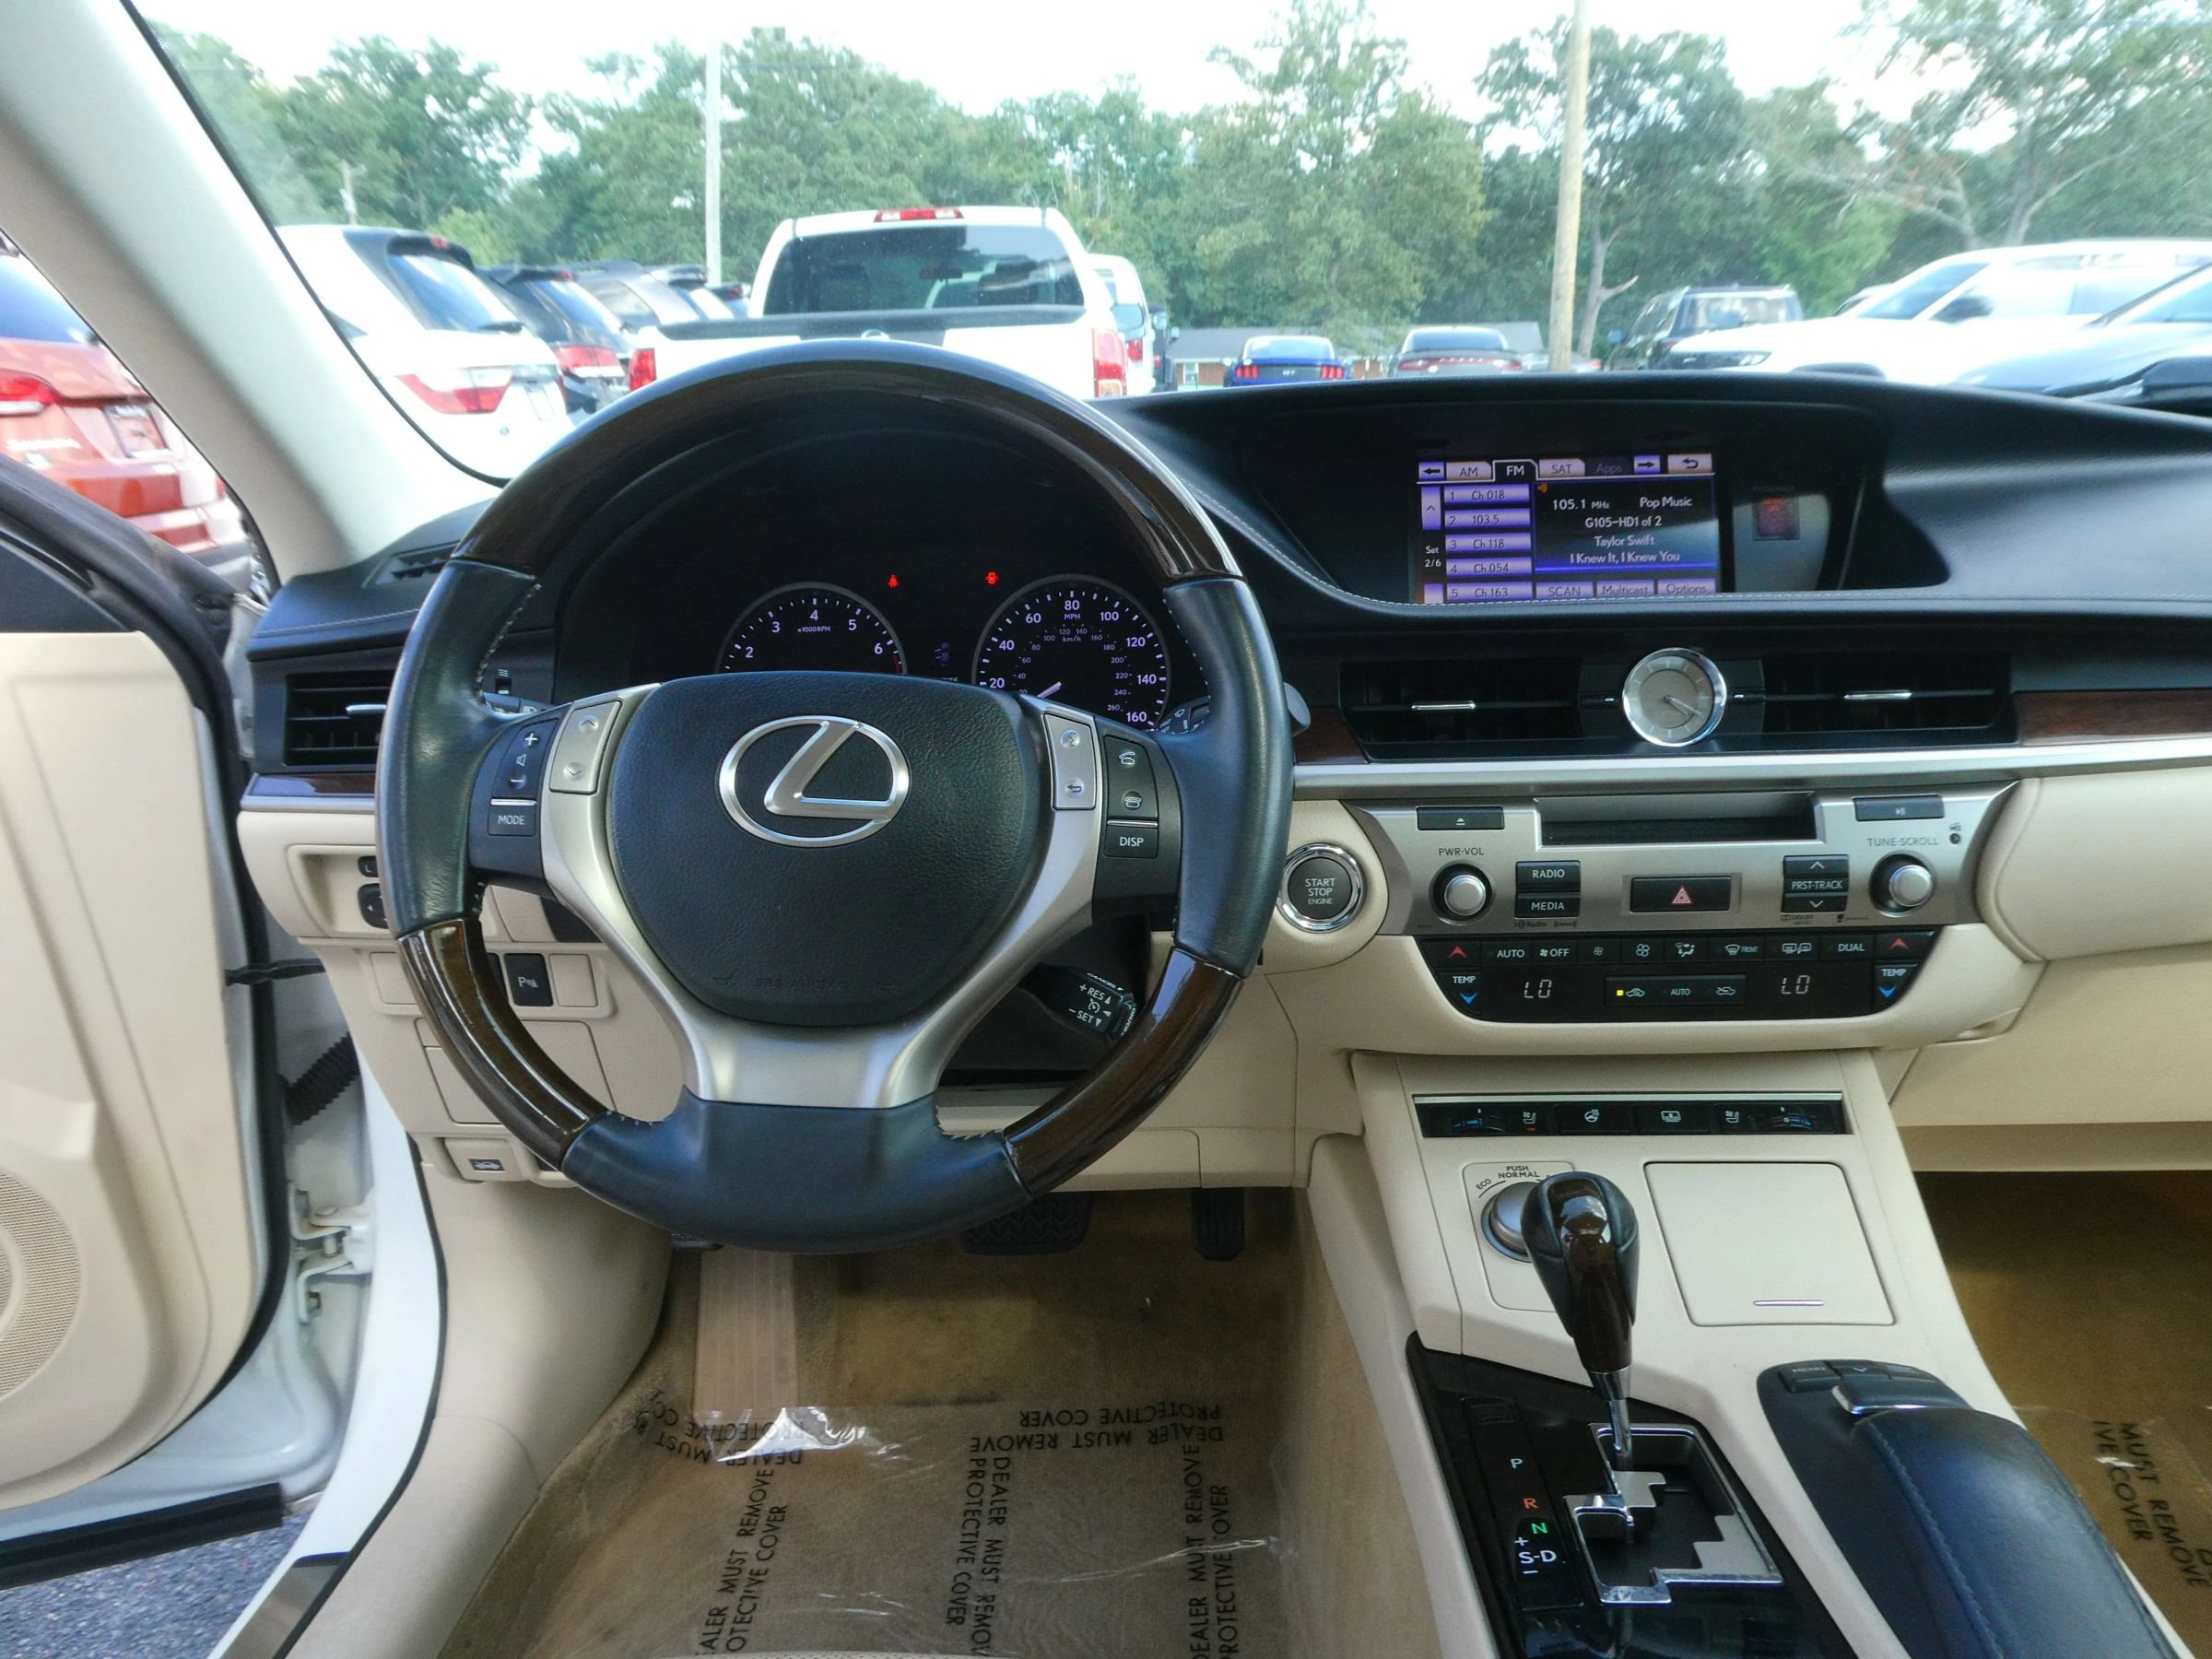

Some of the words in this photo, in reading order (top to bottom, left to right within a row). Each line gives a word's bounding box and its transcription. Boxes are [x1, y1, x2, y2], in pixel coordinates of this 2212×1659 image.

[1459, 466, 1478, 477] AM
[1506, 465, 1525, 477] FM
[1551, 464, 1573, 475] SAT
[1450, 491, 1455, 501] 1
[1471, 490, 1484, 500] Ch
[1487, 489, 1505, 500] 018
[1552, 499, 1586, 511] 105.1
[1591, 500, 1610, 510] MHz
[1640, 496, 1660, 510] Pop
[1662, 495, 1693, 508] Music
[1449, 515, 1456, 525] 2
[1472, 513, 1500, 525] 103.5
[1641, 515, 1653, 527] of
[1654, 515, 1663, 527] 2
[1450, 539, 1457, 550] 3
[1473, 539, 1486, 549] Ch
[1488, 538, 1505, 548] 118
[1594, 535, 1625, 549] Taylor
[1627, 534, 1655, 547] Swift
[1425, 545, 1440, 555] Set
[1576, 552, 1606, 564] Knew
[1627, 551, 1657, 562] Knew
[1659, 550, 1680, 562] You
[1424, 559, 1441, 568] 2/6
[1450, 564, 1458, 574] 4
[1474, 563, 1487, 574] Ch
[1488, 562, 1509, 574] 054
[1452, 589, 1459, 599] 5
[1474, 587, 1488, 598] Ch
[1490, 587, 1508, 598] 163
[1547, 585, 1582, 598] SCAN
[1602, 584, 1649, 596] Multicast
[1666, 582, 1708, 595] Options
[1064, 599, 1080, 611] 80
[810, 609, 818, 621] 4
[1025, 612, 1041, 624] 60
[1100, 610, 1119, 621] 100
[771, 620, 781, 633] 3
[848, 618, 857, 631] 5
[1063, 634, 1082, 642] km/h
[1125, 636, 1146, 648] 120
[874, 642, 883, 654] 6
[998, 640, 1015, 651] 40
[745, 646, 754, 658] 2
[989, 677, 1005, 688] 20
[1136, 674, 1157, 685] 140
[1126, 712, 1147, 723] 160
[498, 815, 526, 826] MODE
[1119, 836, 1144, 848] DISP
[1532, 869, 1565, 879] RADIO
[1305, 877, 1335, 887] START
[1308, 888, 1333, 896] STOP
[1531, 901, 1565, 911] MEDIA
[1549, 948, 1570, 958] OFF
[1837, 943, 1865, 952] DUAL
[1497, 949, 1525, 959] AUTO
[1881, 968, 1907, 977] TEMP
[1453, 975, 1477, 984] TEMP
[1781, 974, 1810, 994] LO
[1087, 987, 1105, 1001] RES
[1524, 979, 1552, 999] LO
[1670, 988, 1690, 996] AUTO
[1077, 1010, 1095, 1024] SET
[1498, 1171, 1540, 1179] NORMAL
[1476, 1178, 1492, 1190] ECO
[1019, 1409, 1088, 1428] COVER
[1099, 1401, 1221, 1425] PROTECTIVE
[1071, 1430, 1133, 1449] MUST
[1148, 1425, 1224, 1444] DEALER
[655, 1431, 712, 1464] MUST
[970, 1431, 1060, 1453] REMOVE
[1510, 1458, 1524, 1469] P
[1182, 1444, 1204, 1524] REMOVE
[987, 1455, 1010, 1526] DEALER
[1524, 1498, 1539, 1509] R
[2109, 1465, 2155, 1542] COVER
[2120, 1421, 2160, 1484] MUST
[2148, 1499, 2211, 1587] REMOVE
[956, 1457, 987, 1565] PROTECTIVE
[1210, 1485, 1231, 1540] OVER
[1531, 1522, 1548, 1535] N
[697, 1606, 729, 1653] ALER
[718, 1549, 749, 1594] MUST
[736, 1468, 775, 1537] REMOVE
[982, 1538, 1003, 1584] MUST
[1186, 1535, 1206, 1582] MUT
[725, 1567, 770, 1653] OTECTIVE
[756, 1504, 788, 1562] COVER
[946, 1571, 972, 1628] COVER
[1213, 1552, 1241, 1659] ROTECTIVE
[971, 1594, 996, 1657] REMOV
